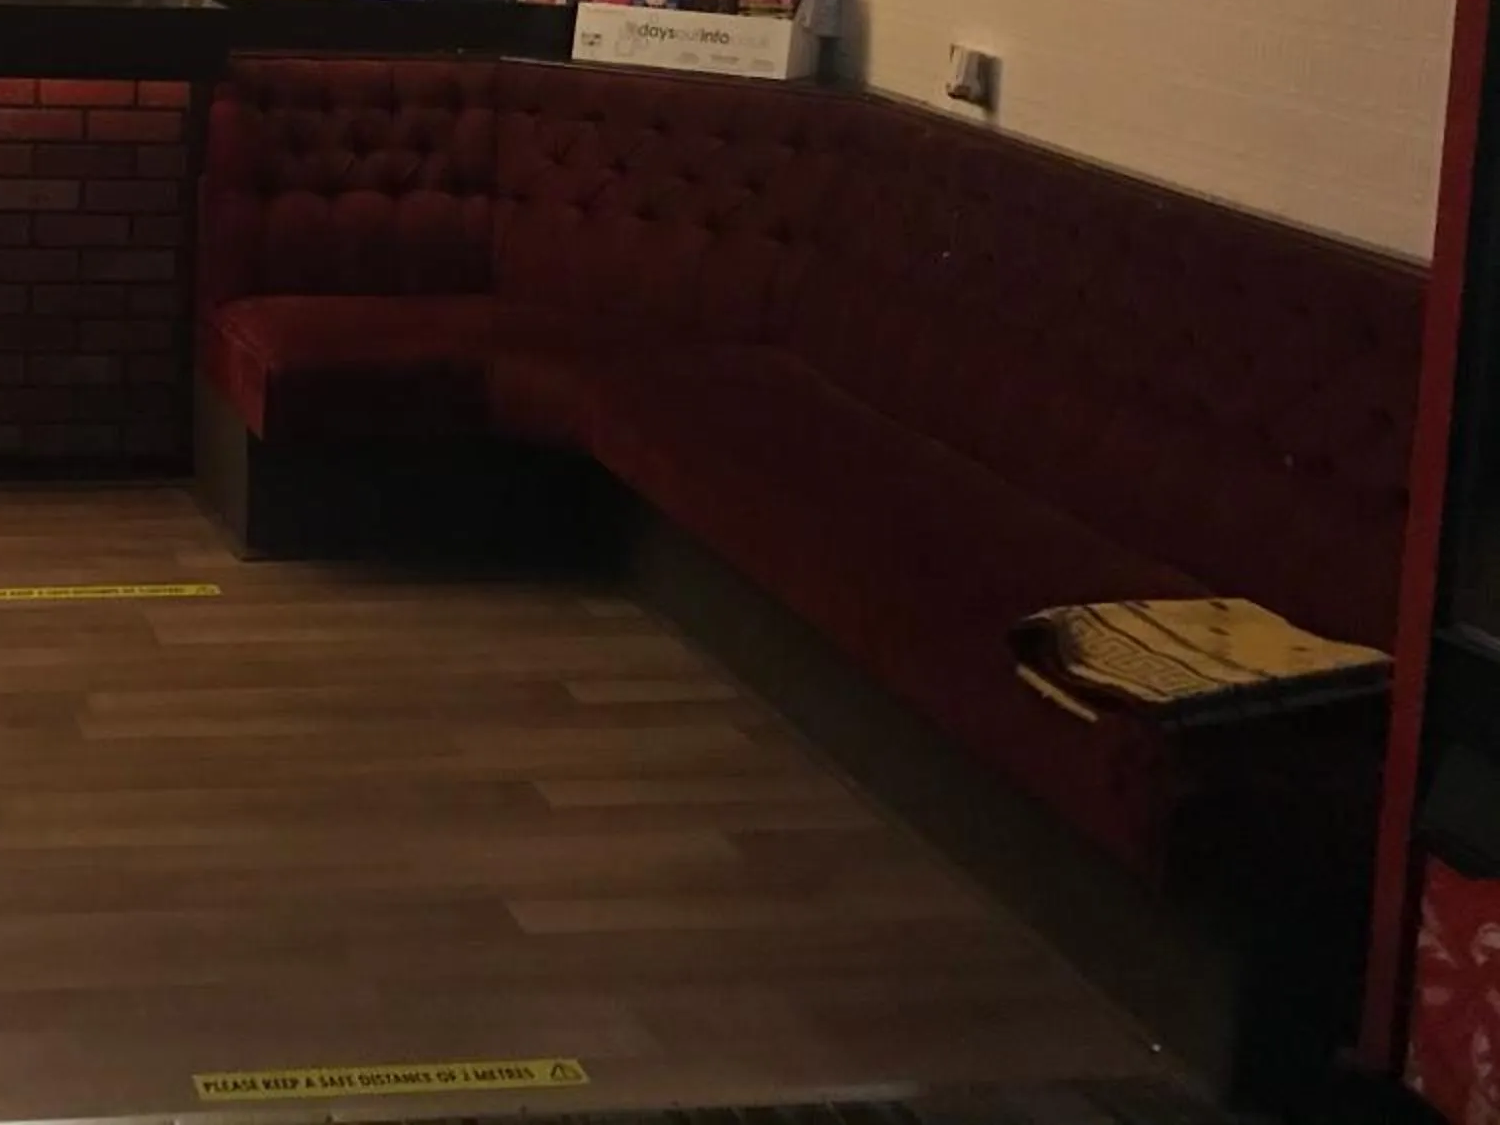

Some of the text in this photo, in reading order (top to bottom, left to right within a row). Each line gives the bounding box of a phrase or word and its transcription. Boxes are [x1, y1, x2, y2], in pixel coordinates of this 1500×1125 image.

[203, 1079, 257, 1093] PLEASE
[262, 1077, 299, 1090] KEEP
[305, 1077, 316, 1088] A
[321, 1074, 354, 1088] SAFE
[358, 1071, 432, 1086] DISTANCE
[436, 1068, 457, 1083] OF
[474, 1066, 536, 1081] METRES
